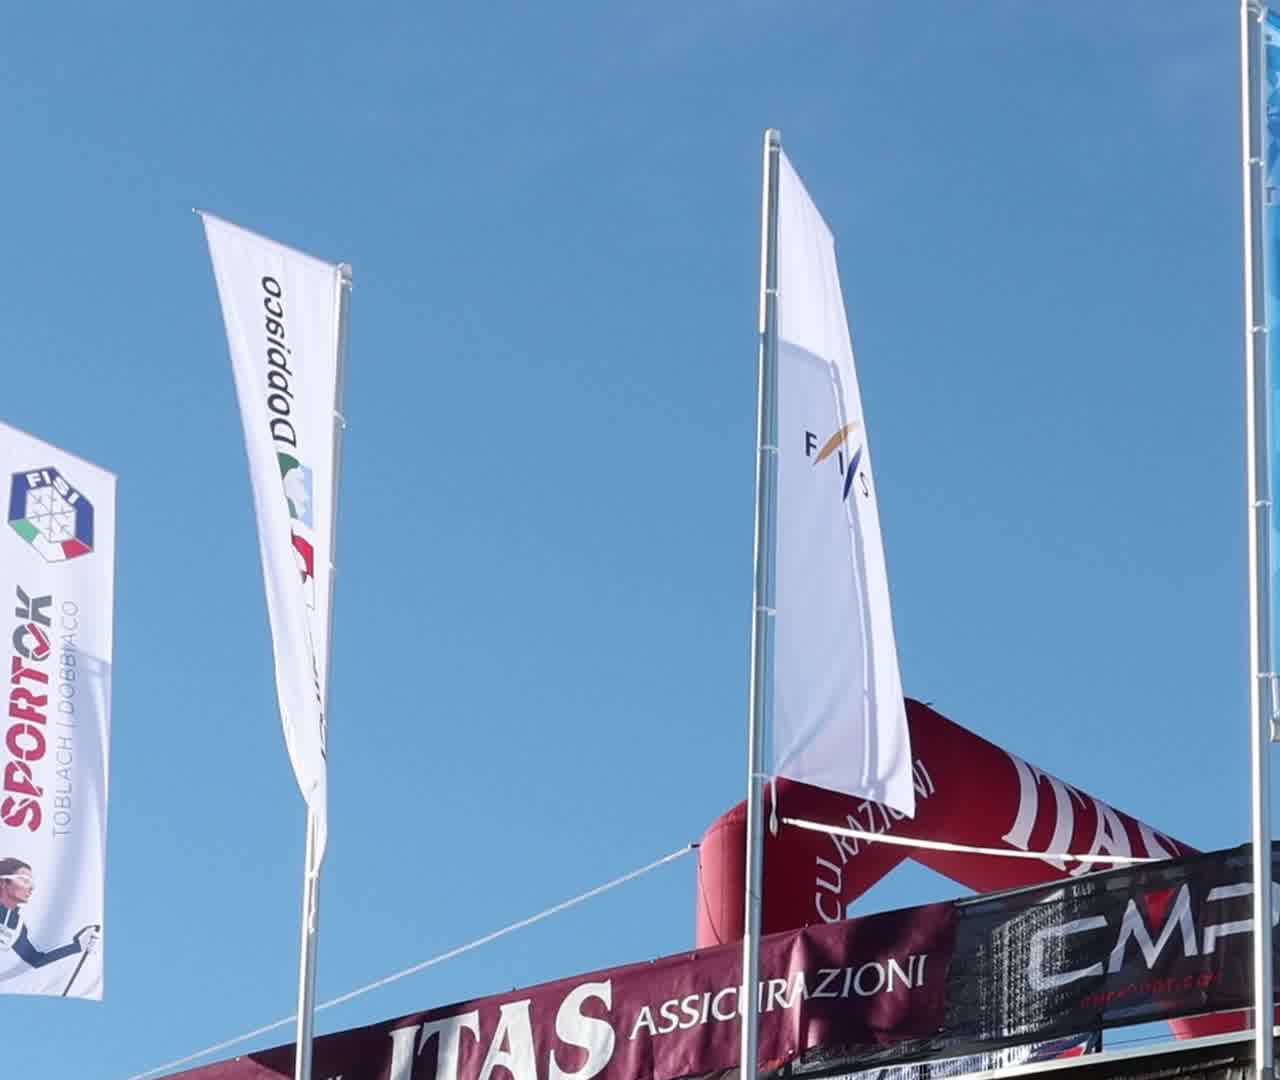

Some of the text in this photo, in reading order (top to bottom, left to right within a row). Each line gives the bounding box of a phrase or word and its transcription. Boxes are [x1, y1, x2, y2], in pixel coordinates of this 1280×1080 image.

[1, 584, 53, 832] SPORTOK
[57, 599, 80, 716] DOBBIACO
[52, 736, 74, 840] TOBLACH
